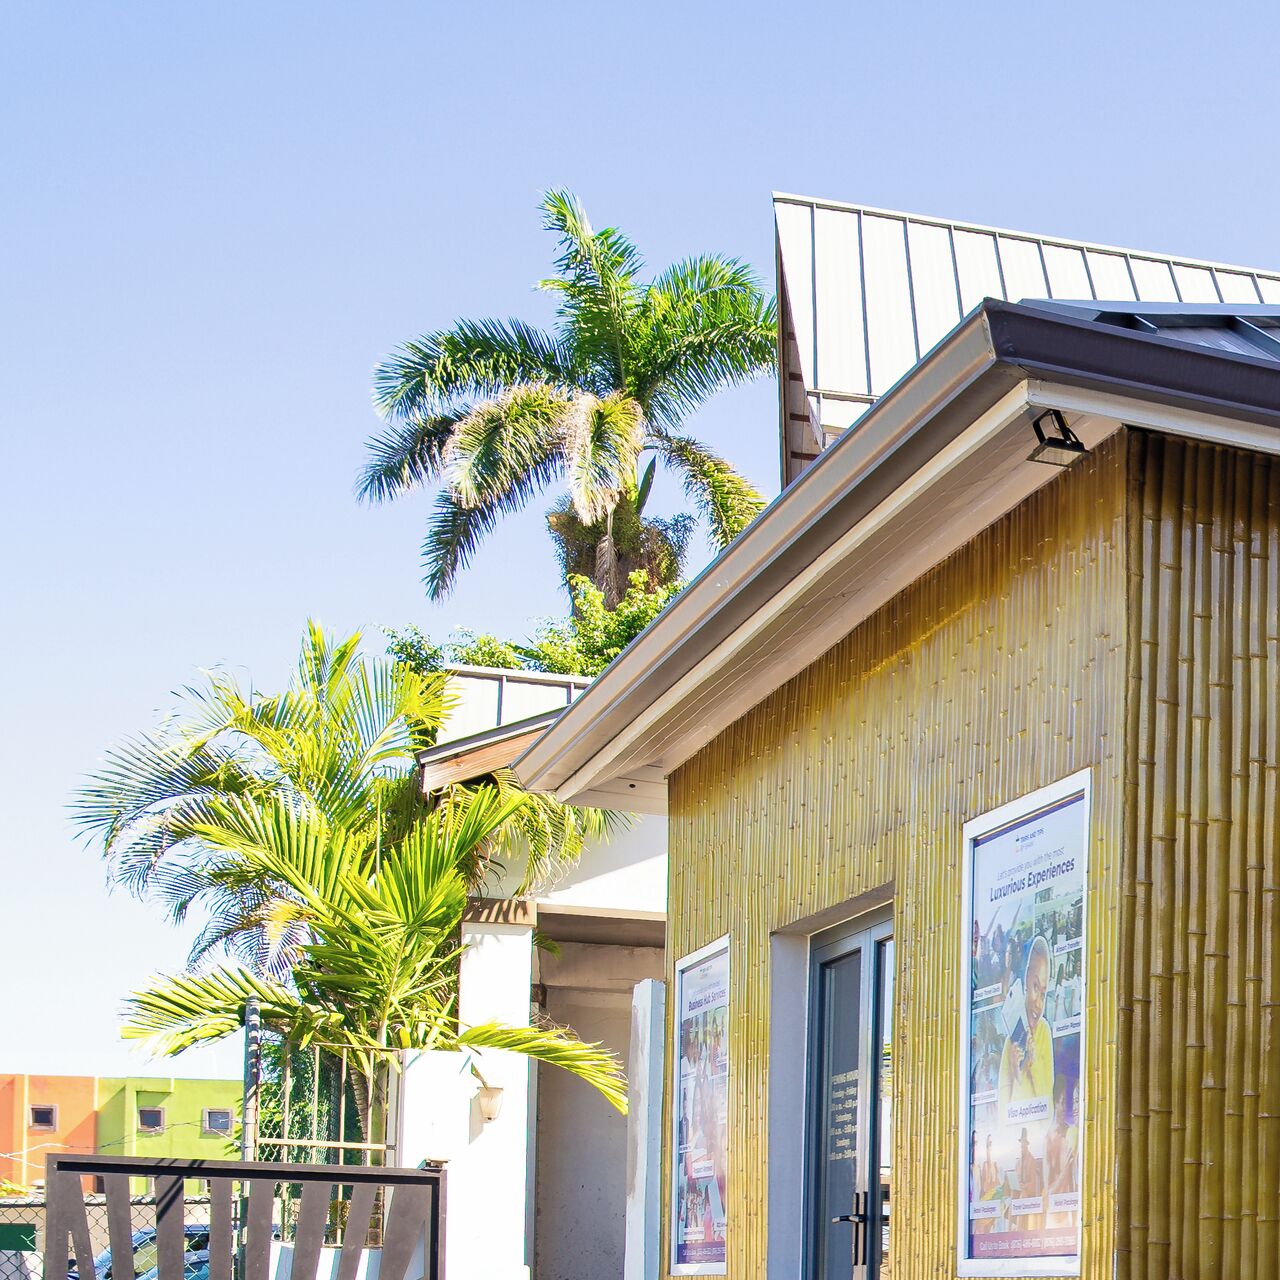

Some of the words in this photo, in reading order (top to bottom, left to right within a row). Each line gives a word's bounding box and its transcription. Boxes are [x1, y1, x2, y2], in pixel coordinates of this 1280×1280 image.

[990, 877, 1026, 902] Luxurious
[1027, 858, 1075, 888] Experiences
[688, 998, 703, 1012] Business
[1019, 1101, 1048, 1118] Application
